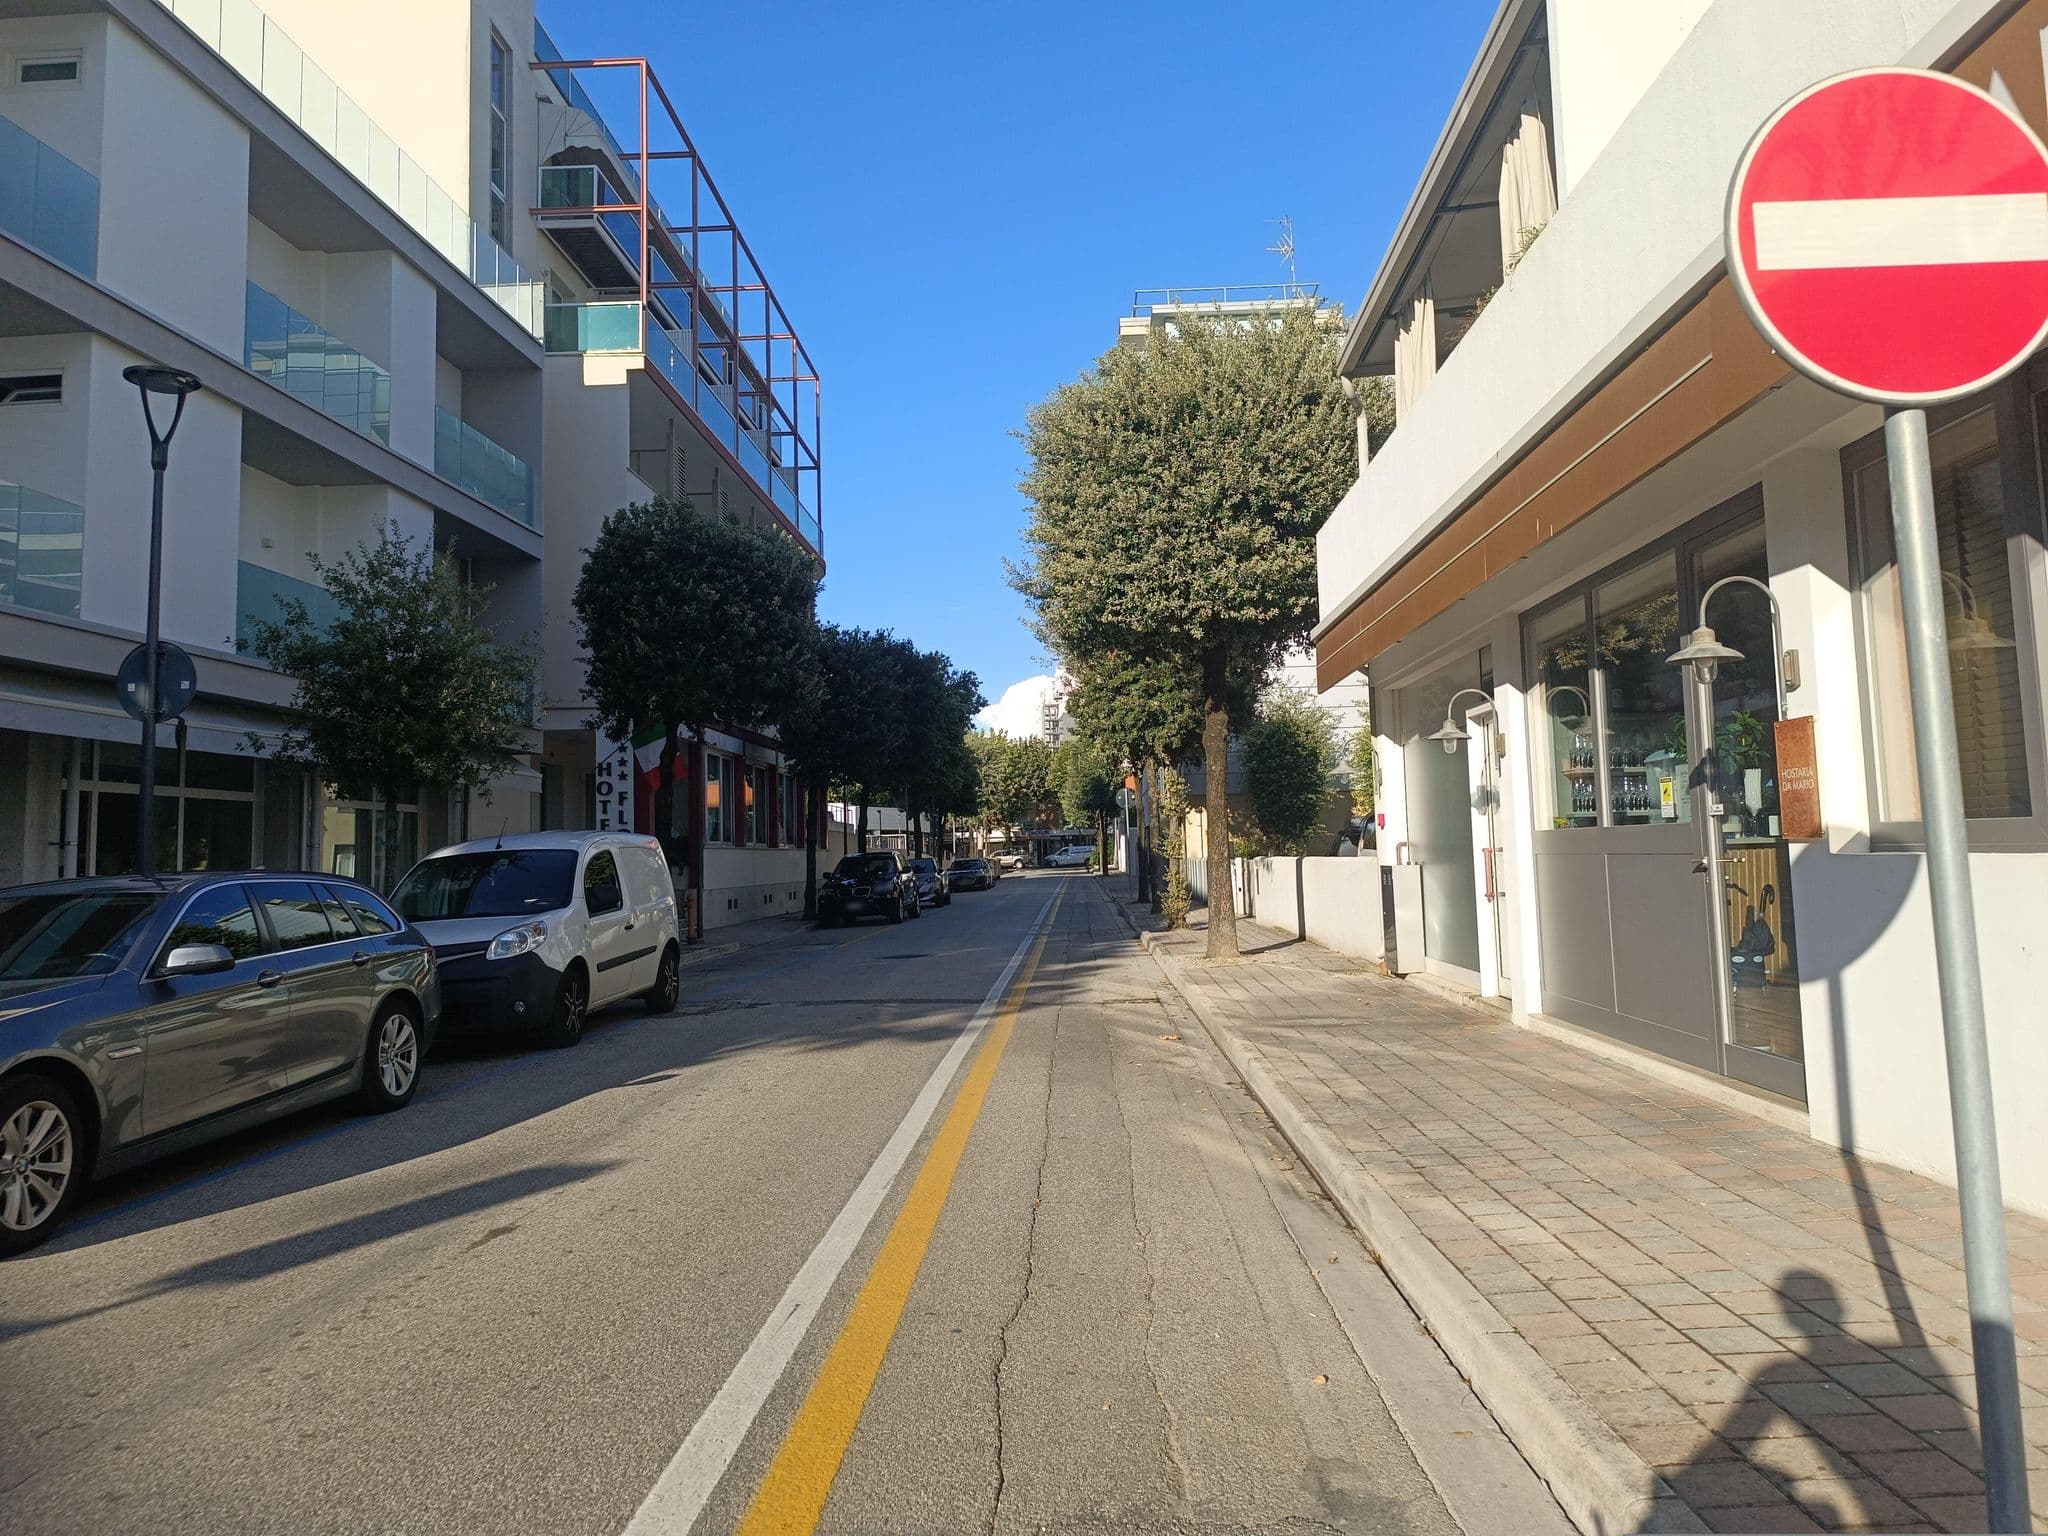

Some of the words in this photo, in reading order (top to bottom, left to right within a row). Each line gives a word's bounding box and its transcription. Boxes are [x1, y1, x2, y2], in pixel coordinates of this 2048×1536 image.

[1781, 767, 1814, 780] HOSTARIA
[1783, 780, 1793, 791] DA
[1794, 778, 1815, 791] MARIO
[618, 791, 631, 833] FL
